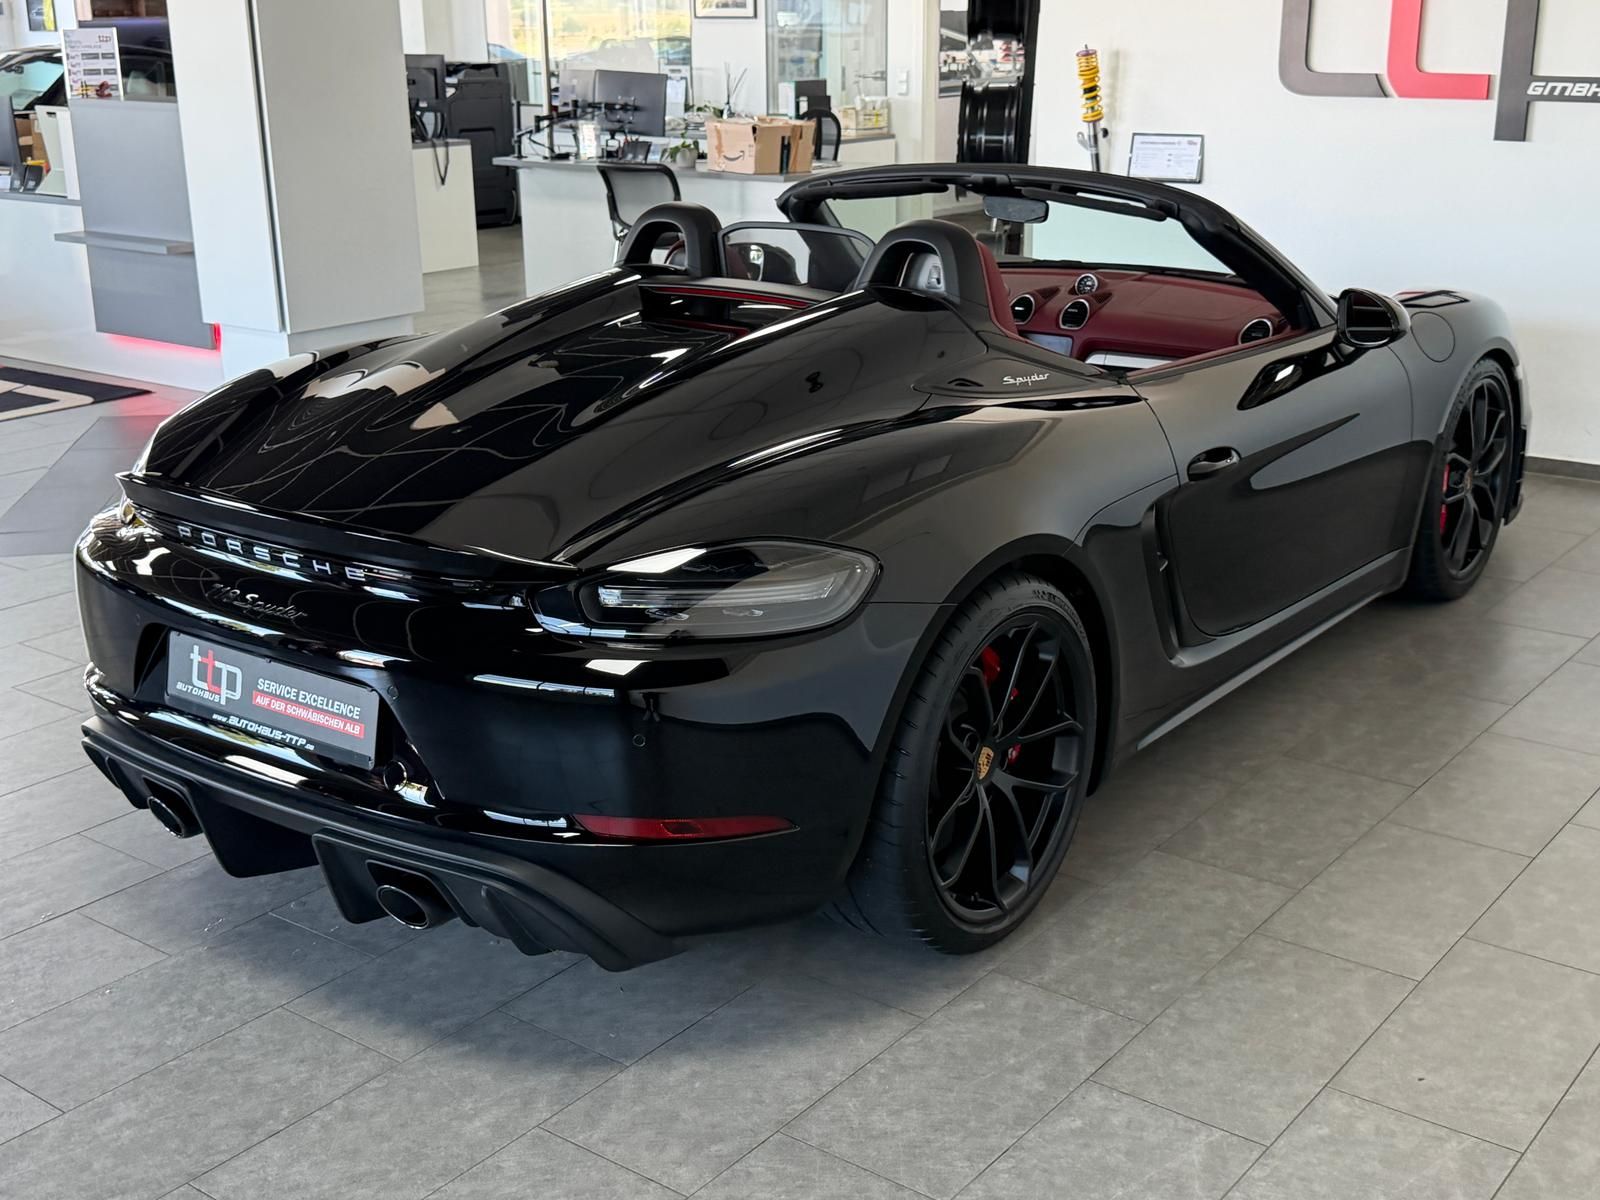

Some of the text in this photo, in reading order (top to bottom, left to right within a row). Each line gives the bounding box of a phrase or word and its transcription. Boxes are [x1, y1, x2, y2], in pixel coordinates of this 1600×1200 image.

[1002, 373, 1050, 386] Spyder
[177, 525, 367, 582] PORSCHE
[232, 593, 309, 620] Spyder
[176, 681, 221, 703] AUTOHAUS
[257, 678, 361, 719] SERVICE EXCELLENCE
[255, 695, 361, 735] AUF DER SCHWÄBISCHEN ALB
